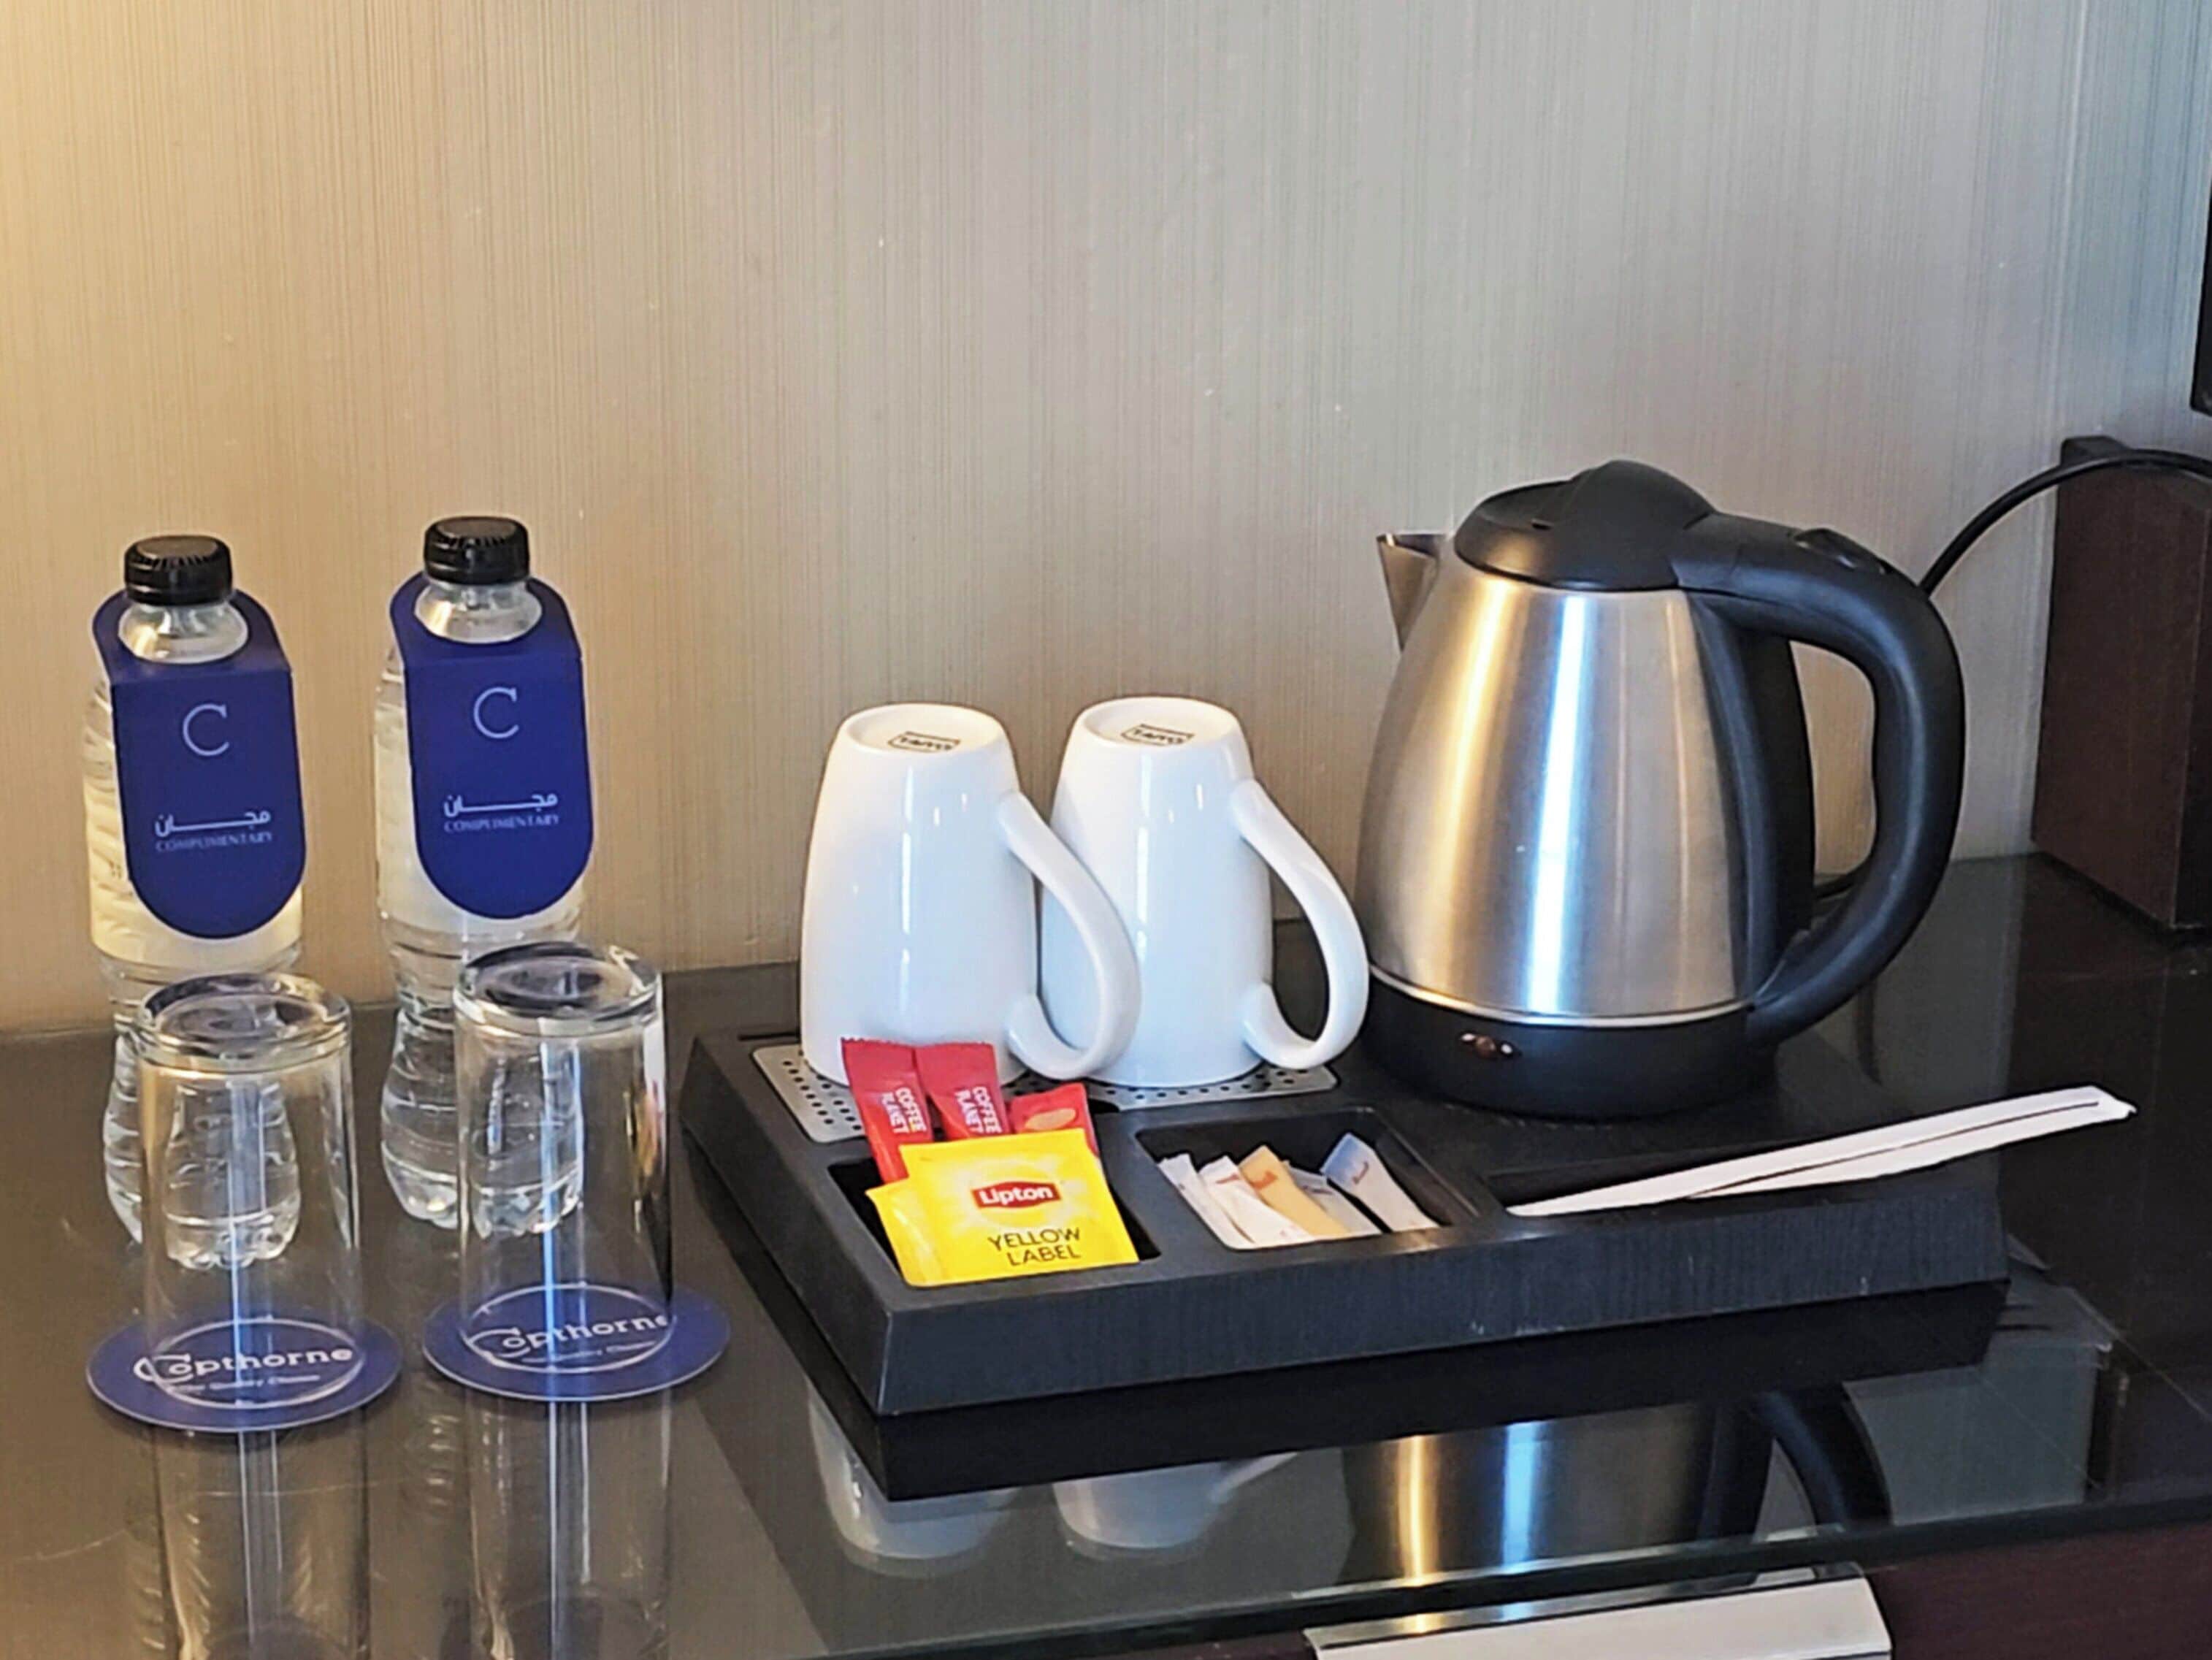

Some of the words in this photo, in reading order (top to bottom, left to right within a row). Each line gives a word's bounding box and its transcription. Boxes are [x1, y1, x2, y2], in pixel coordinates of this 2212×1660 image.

[182, 703, 229, 755] C
[472, 686, 519, 738] C
[895, 1086, 927, 1132] COFFEE
[971, 1085, 1003, 1133] COFFEE
[979, 1186, 1054, 1206] Lipton
[987, 1227, 1081, 1251] YELLOW
[1006, 1244, 1082, 1266] LABEL
